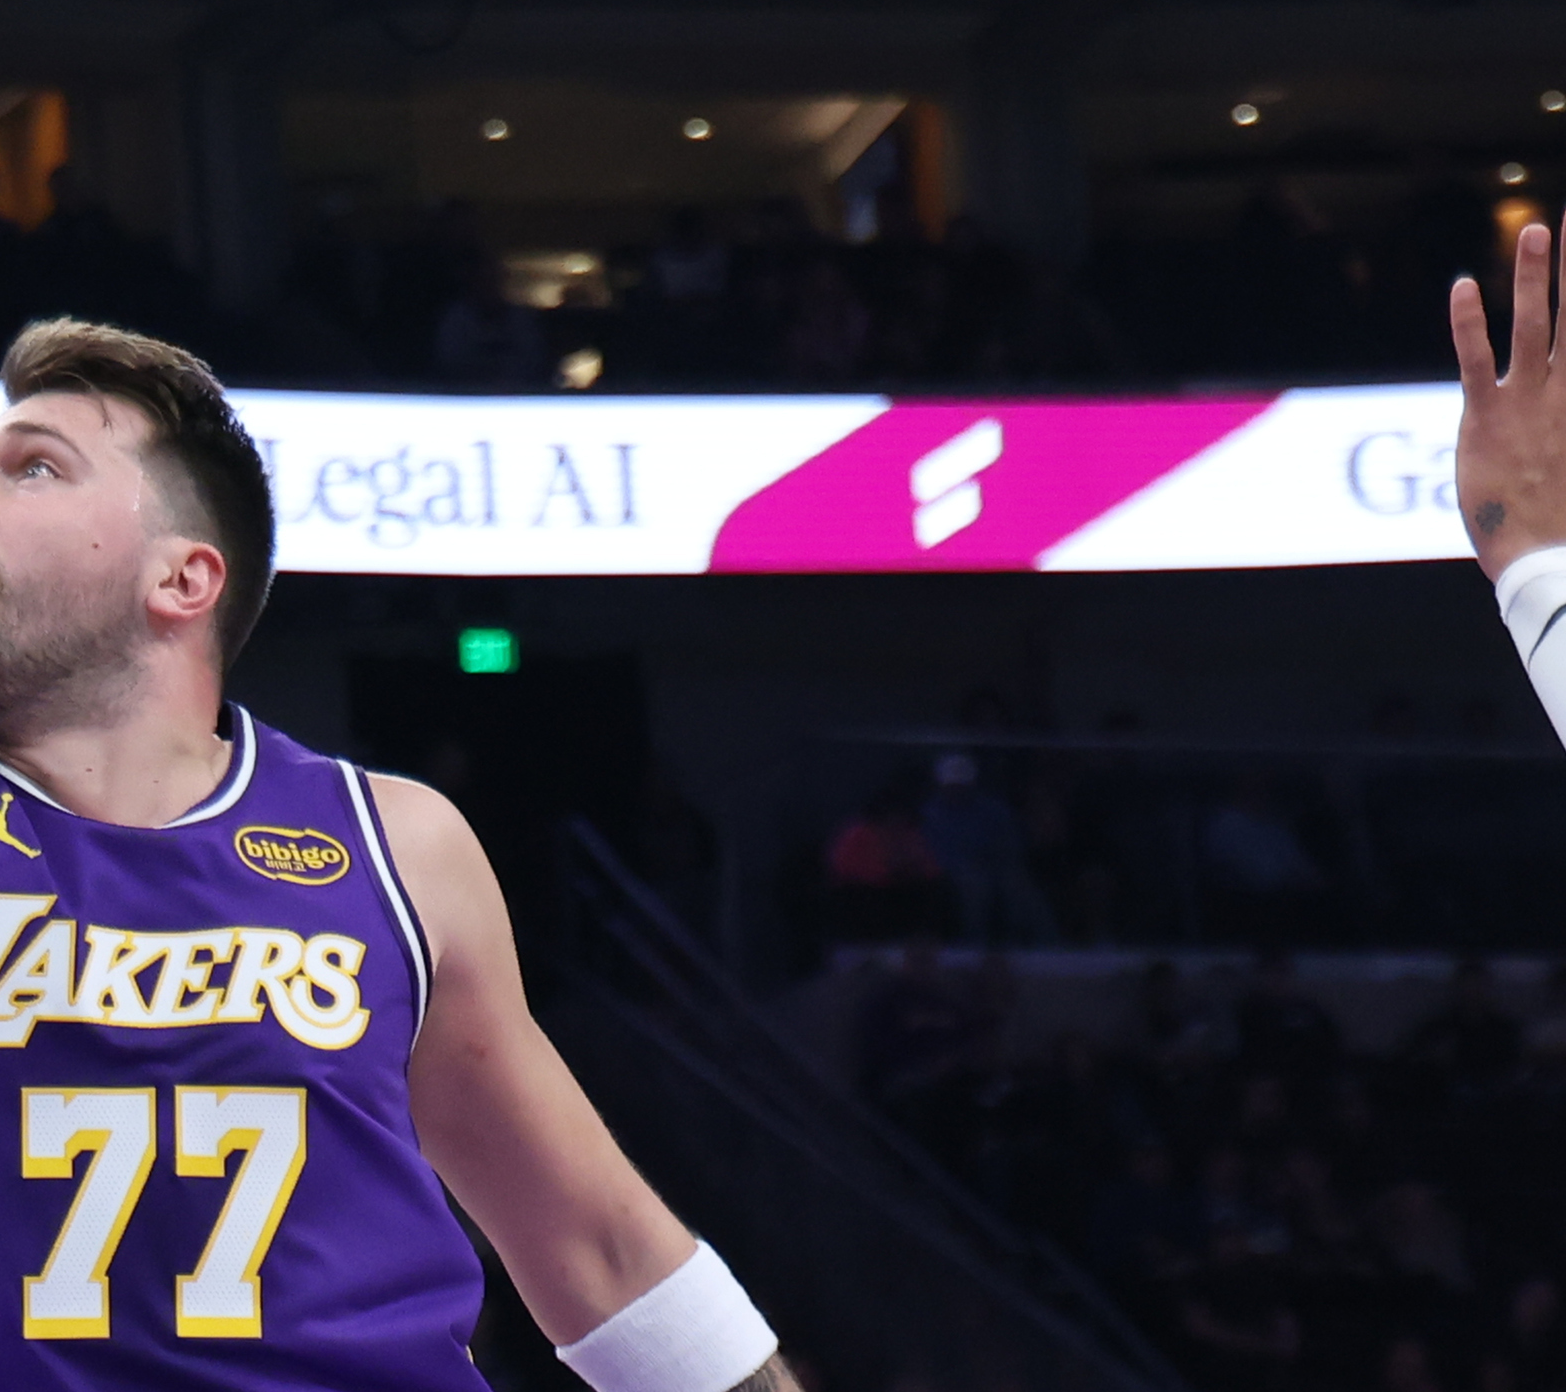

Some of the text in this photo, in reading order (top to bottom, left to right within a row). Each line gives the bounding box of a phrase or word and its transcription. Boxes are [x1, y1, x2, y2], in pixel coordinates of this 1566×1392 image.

[526, 443, 644, 527] AI
[243, 836, 342, 870] bibigo
[20, 1085, 308, 1340] 77
